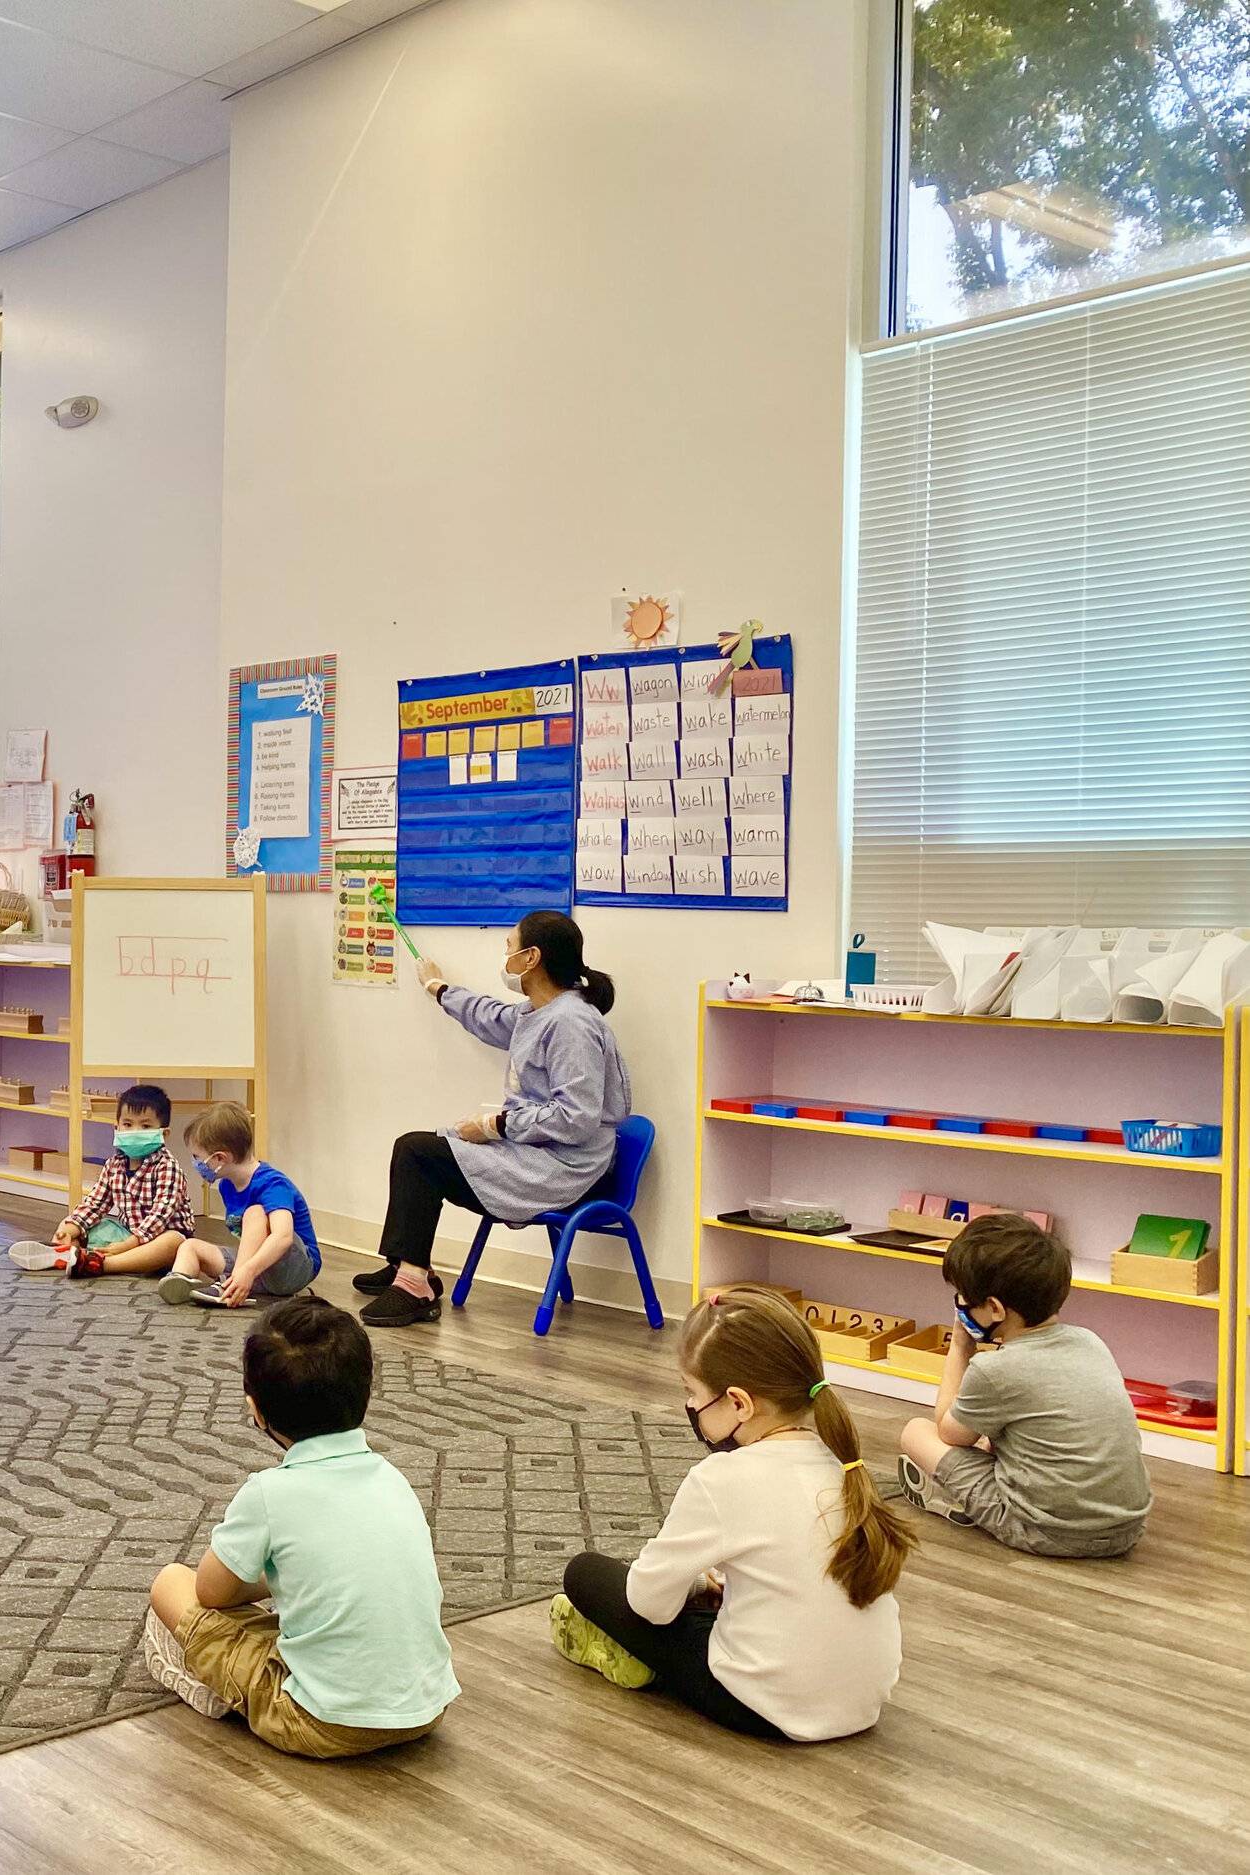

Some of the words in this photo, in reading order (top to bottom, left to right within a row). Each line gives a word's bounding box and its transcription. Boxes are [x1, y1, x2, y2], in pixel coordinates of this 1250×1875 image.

[632, 678, 673, 698] wagon
[742, 675, 776, 692] 2021
[426, 695, 509, 722] September
[536, 687, 569, 708] 2021
[633, 707, 671, 733] waste
[685, 703, 727, 729] wake
[633, 745, 666, 770] wall
[685, 746, 724, 768] wash
[735, 742, 781, 765] white
[628, 785, 664, 809] wind
[678, 786, 713, 808] well
[732, 781, 776, 806] where
[630, 824, 670, 848] when
[680, 829, 715, 853] way
[733, 829, 780, 844] warm
[581, 865, 615, 881] wow
[676, 864, 717, 884] wish
[733, 869, 781, 887] wave
[850, 1314, 863, 1328] 2
[871, 1318, 884, 1333] 3
